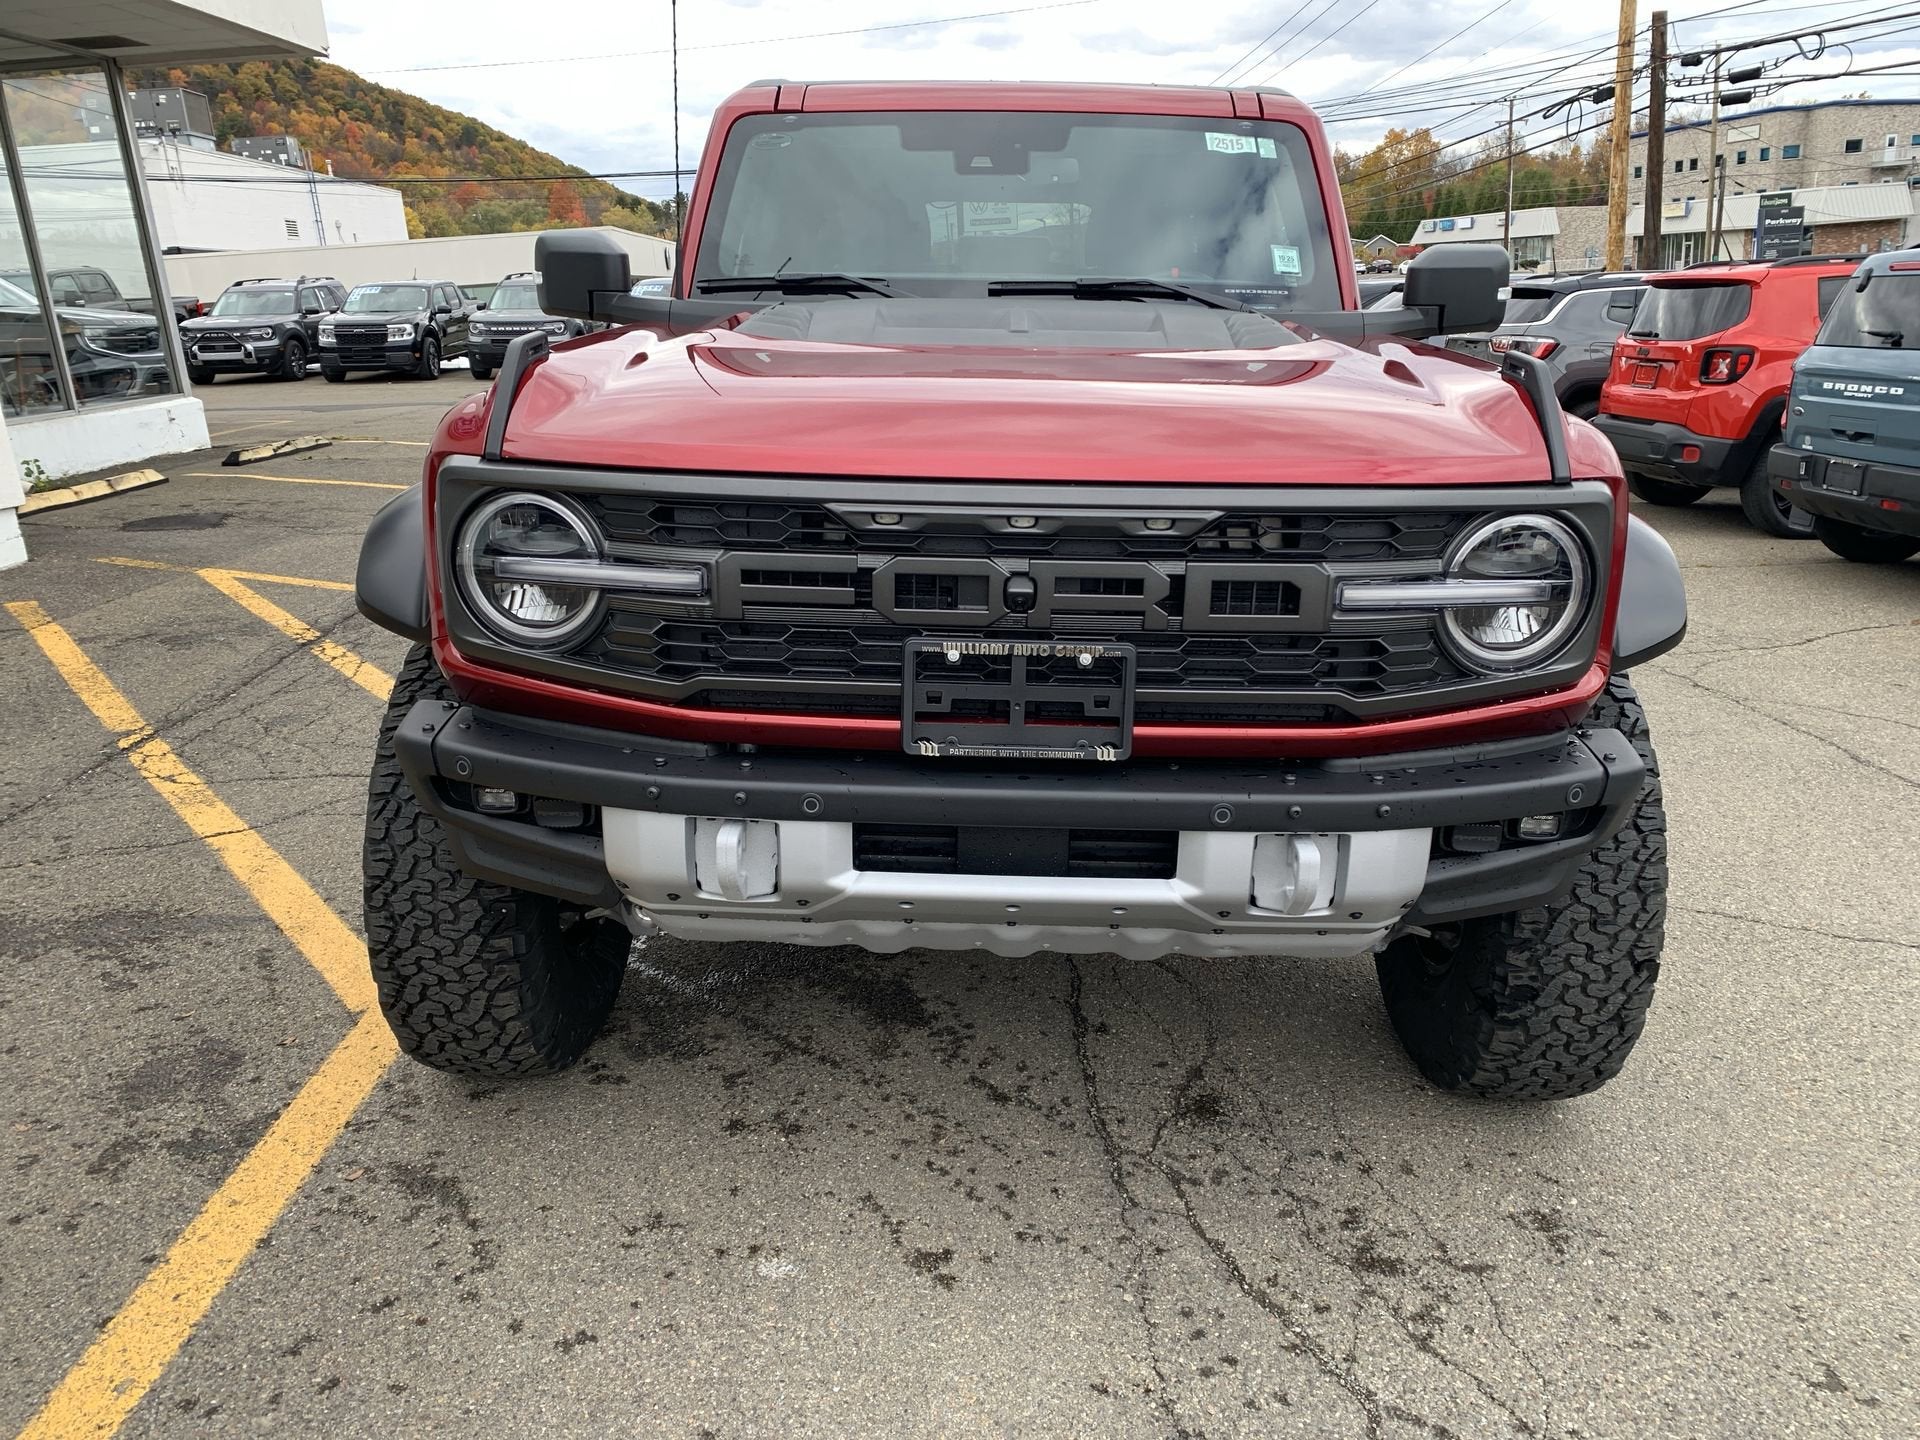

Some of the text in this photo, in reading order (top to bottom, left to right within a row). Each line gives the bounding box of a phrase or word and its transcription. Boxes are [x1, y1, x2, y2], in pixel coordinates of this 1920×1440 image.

[1214, 137, 1244, 151] 2515
[1765, 217, 1802, 226] Parkway
[1823, 381, 1904, 396] BRONCO
[1843, 391, 1874, 399] SPORT
[715, 551, 1330, 632] FORD
[1013, 643, 1050, 657] AUTO
[949, 748, 1085, 759] PARTNERING WITH THE COMMUNITY
